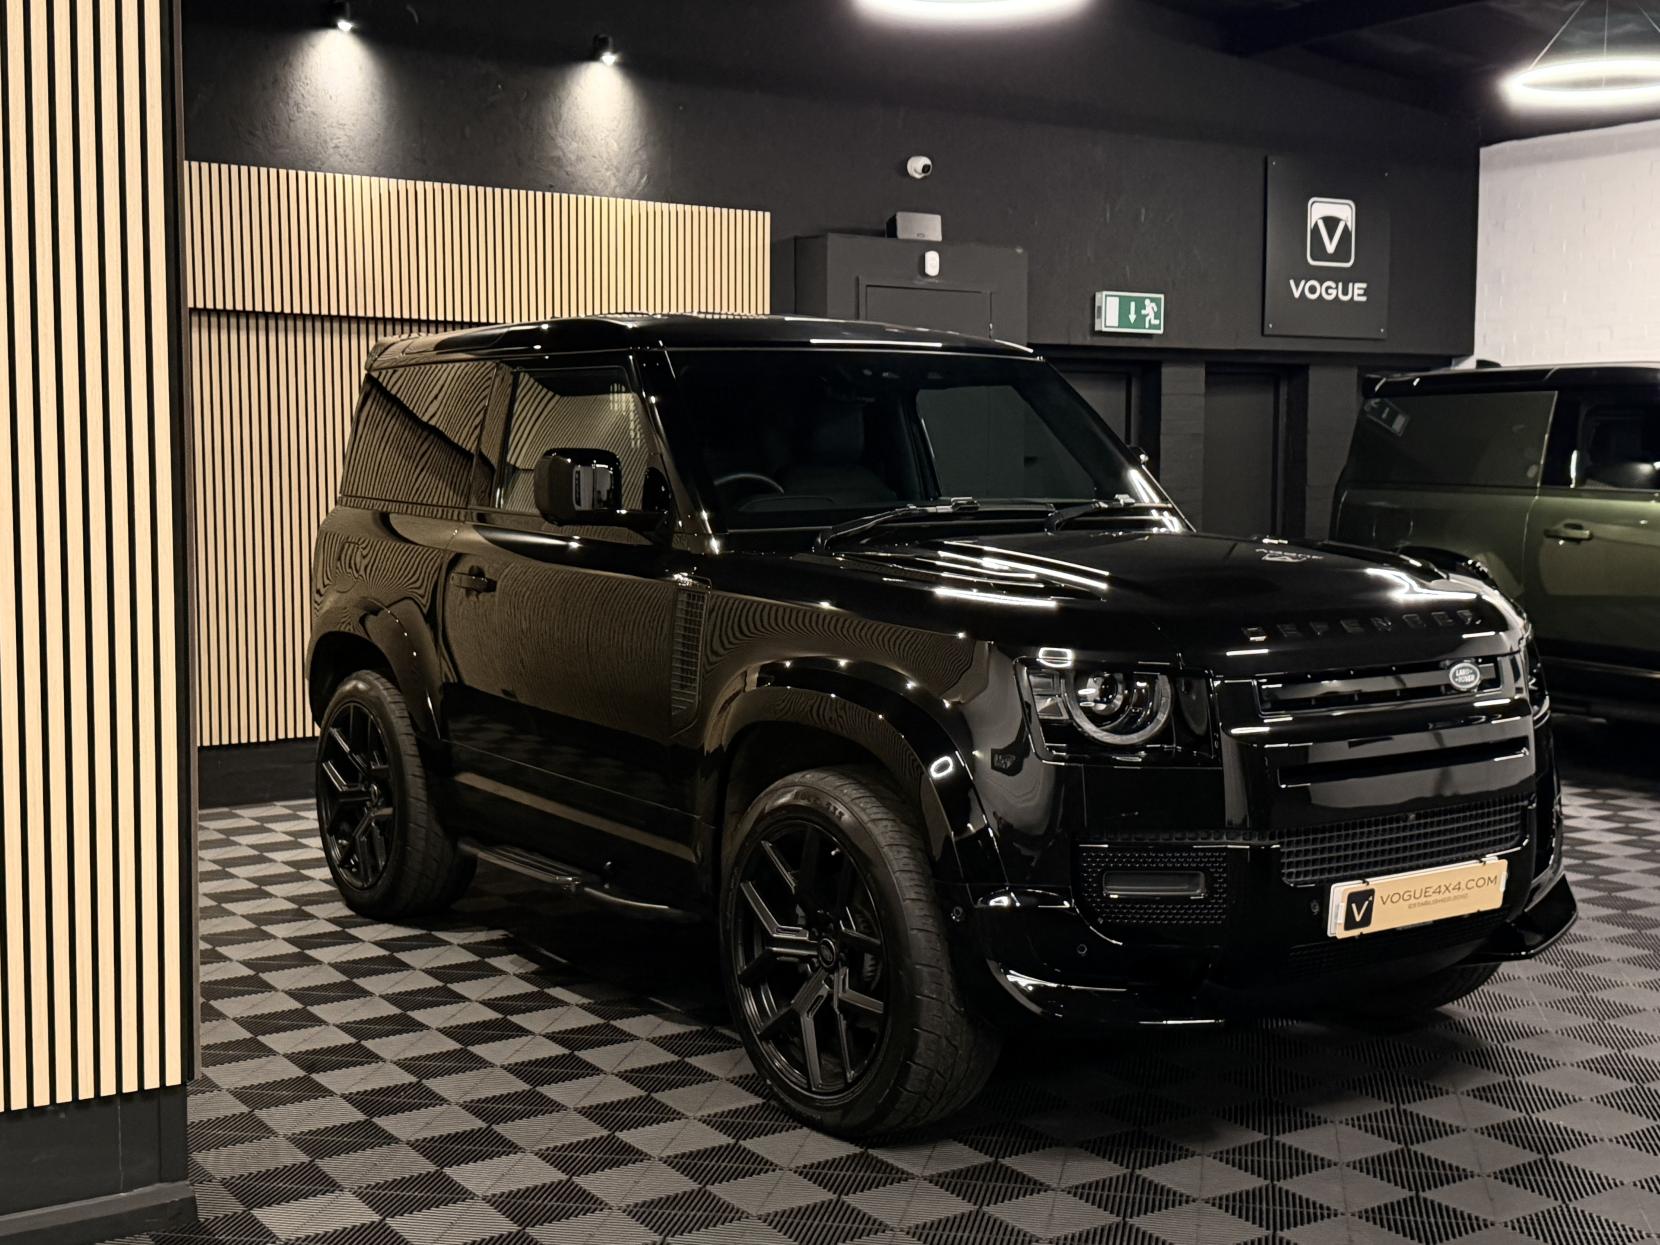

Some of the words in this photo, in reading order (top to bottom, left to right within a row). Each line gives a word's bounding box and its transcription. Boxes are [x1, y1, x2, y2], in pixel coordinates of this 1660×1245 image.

[1316, 218, 1346, 254] V
[1289, 279, 1368, 302] VOGUE
[1380, 875, 1498, 906] VOGUE4X4.COM
[1351, 896, 1373, 922] V
